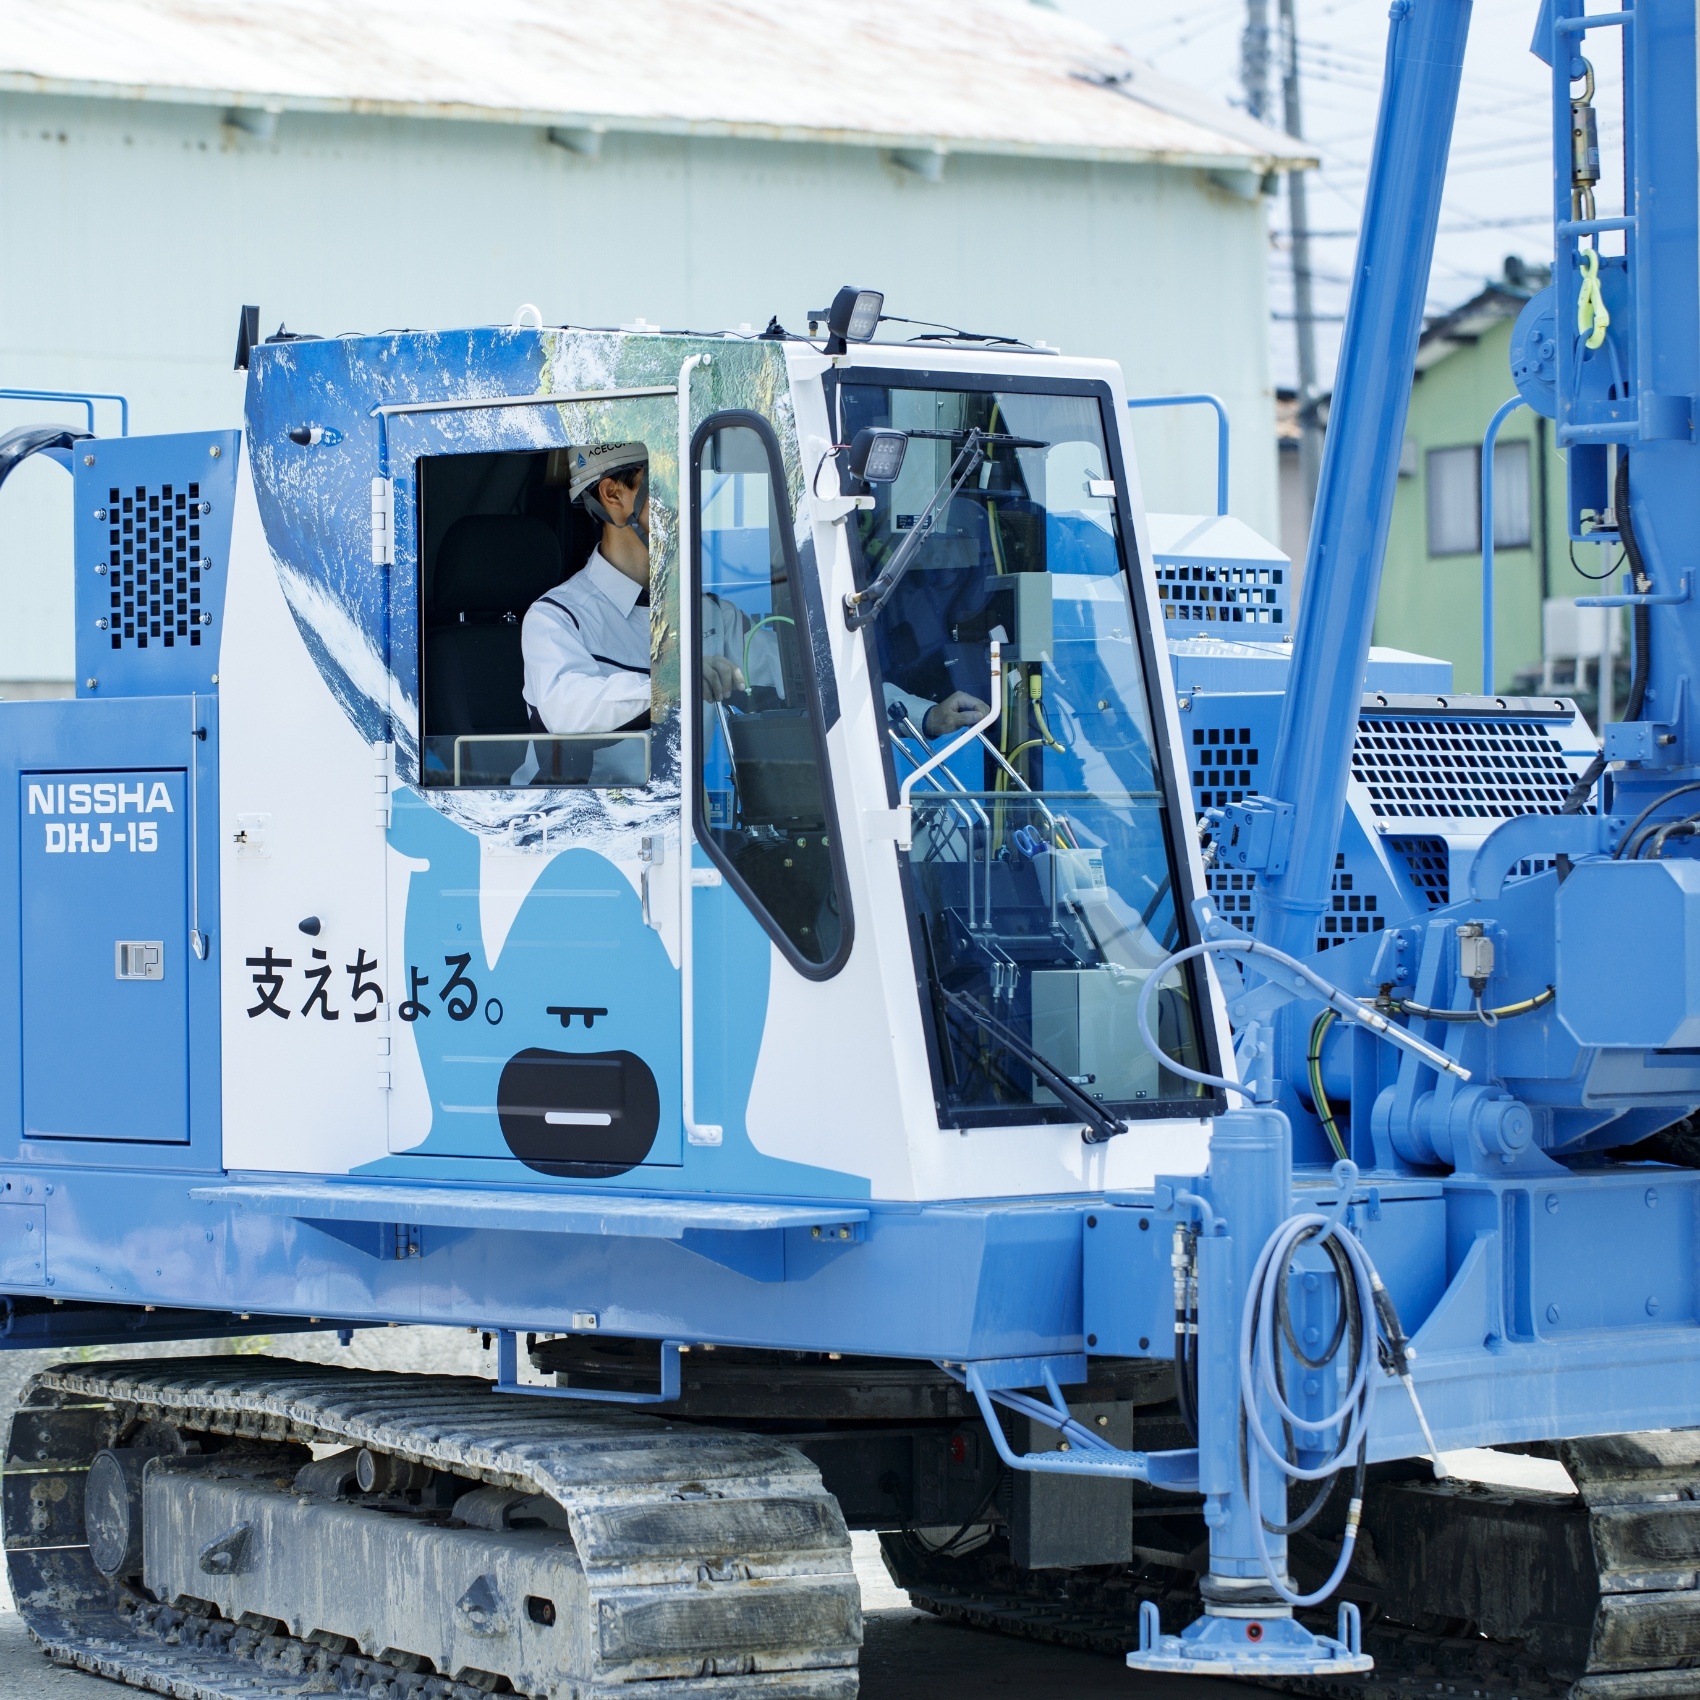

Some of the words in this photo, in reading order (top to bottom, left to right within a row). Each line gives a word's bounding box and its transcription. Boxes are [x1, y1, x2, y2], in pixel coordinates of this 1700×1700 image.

[28, 782, 174, 814] NISSHA
[45, 822, 158, 853] DHJ-15
[246, 946, 504, 1026] 支えちょる。
